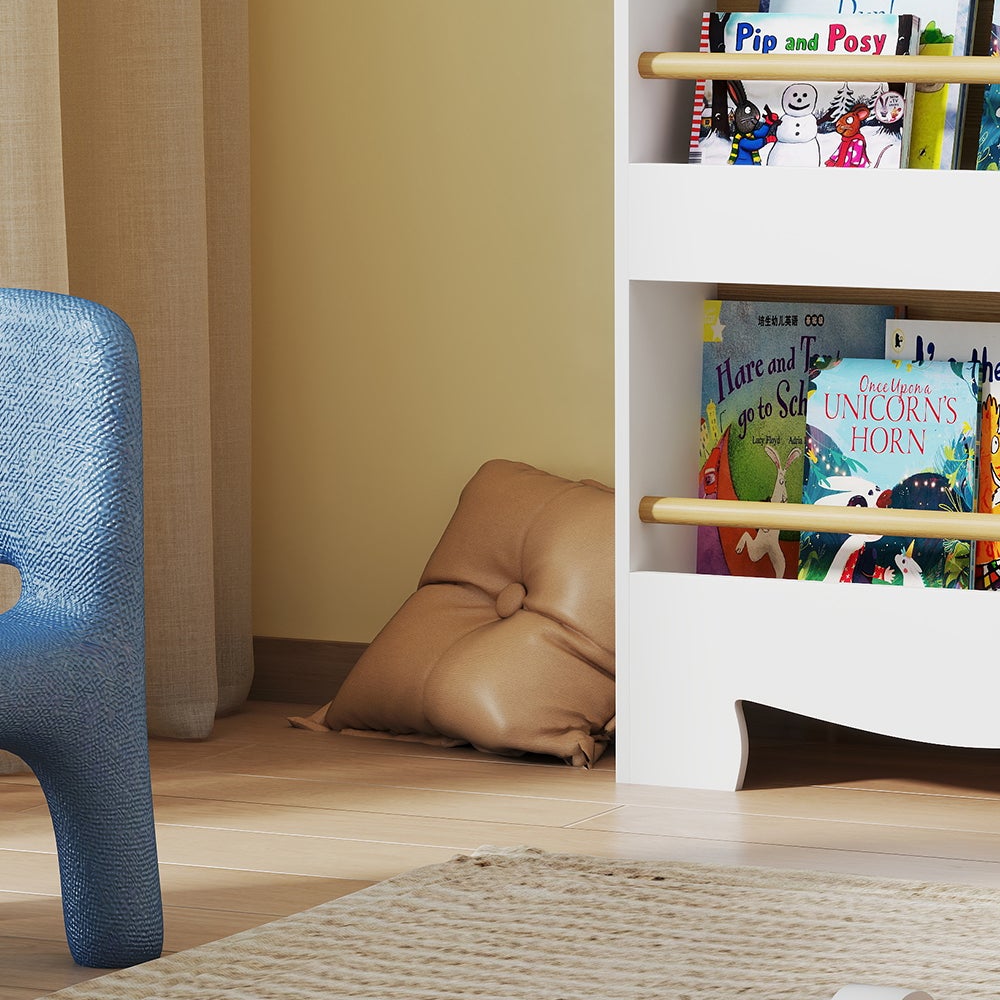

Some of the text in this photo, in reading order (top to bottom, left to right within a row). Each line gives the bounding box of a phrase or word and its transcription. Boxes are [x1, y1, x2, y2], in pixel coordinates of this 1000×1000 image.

[735, 23, 887, 55] Pip and Posy
[758, 314, 798, 326] 培生幼儿英语
[716, 357, 764, 404] Hare
[768, 347, 795, 375] and
[859, 374, 932, 404] Once Upon a
[738, 379, 807, 440] go to Sch
[824, 393, 957, 424] UNICORN'S
[752, 435, 765, 445] Lucy
[765, 435, 781, 446] Floyd
[850, 426, 926, 455] HORN
